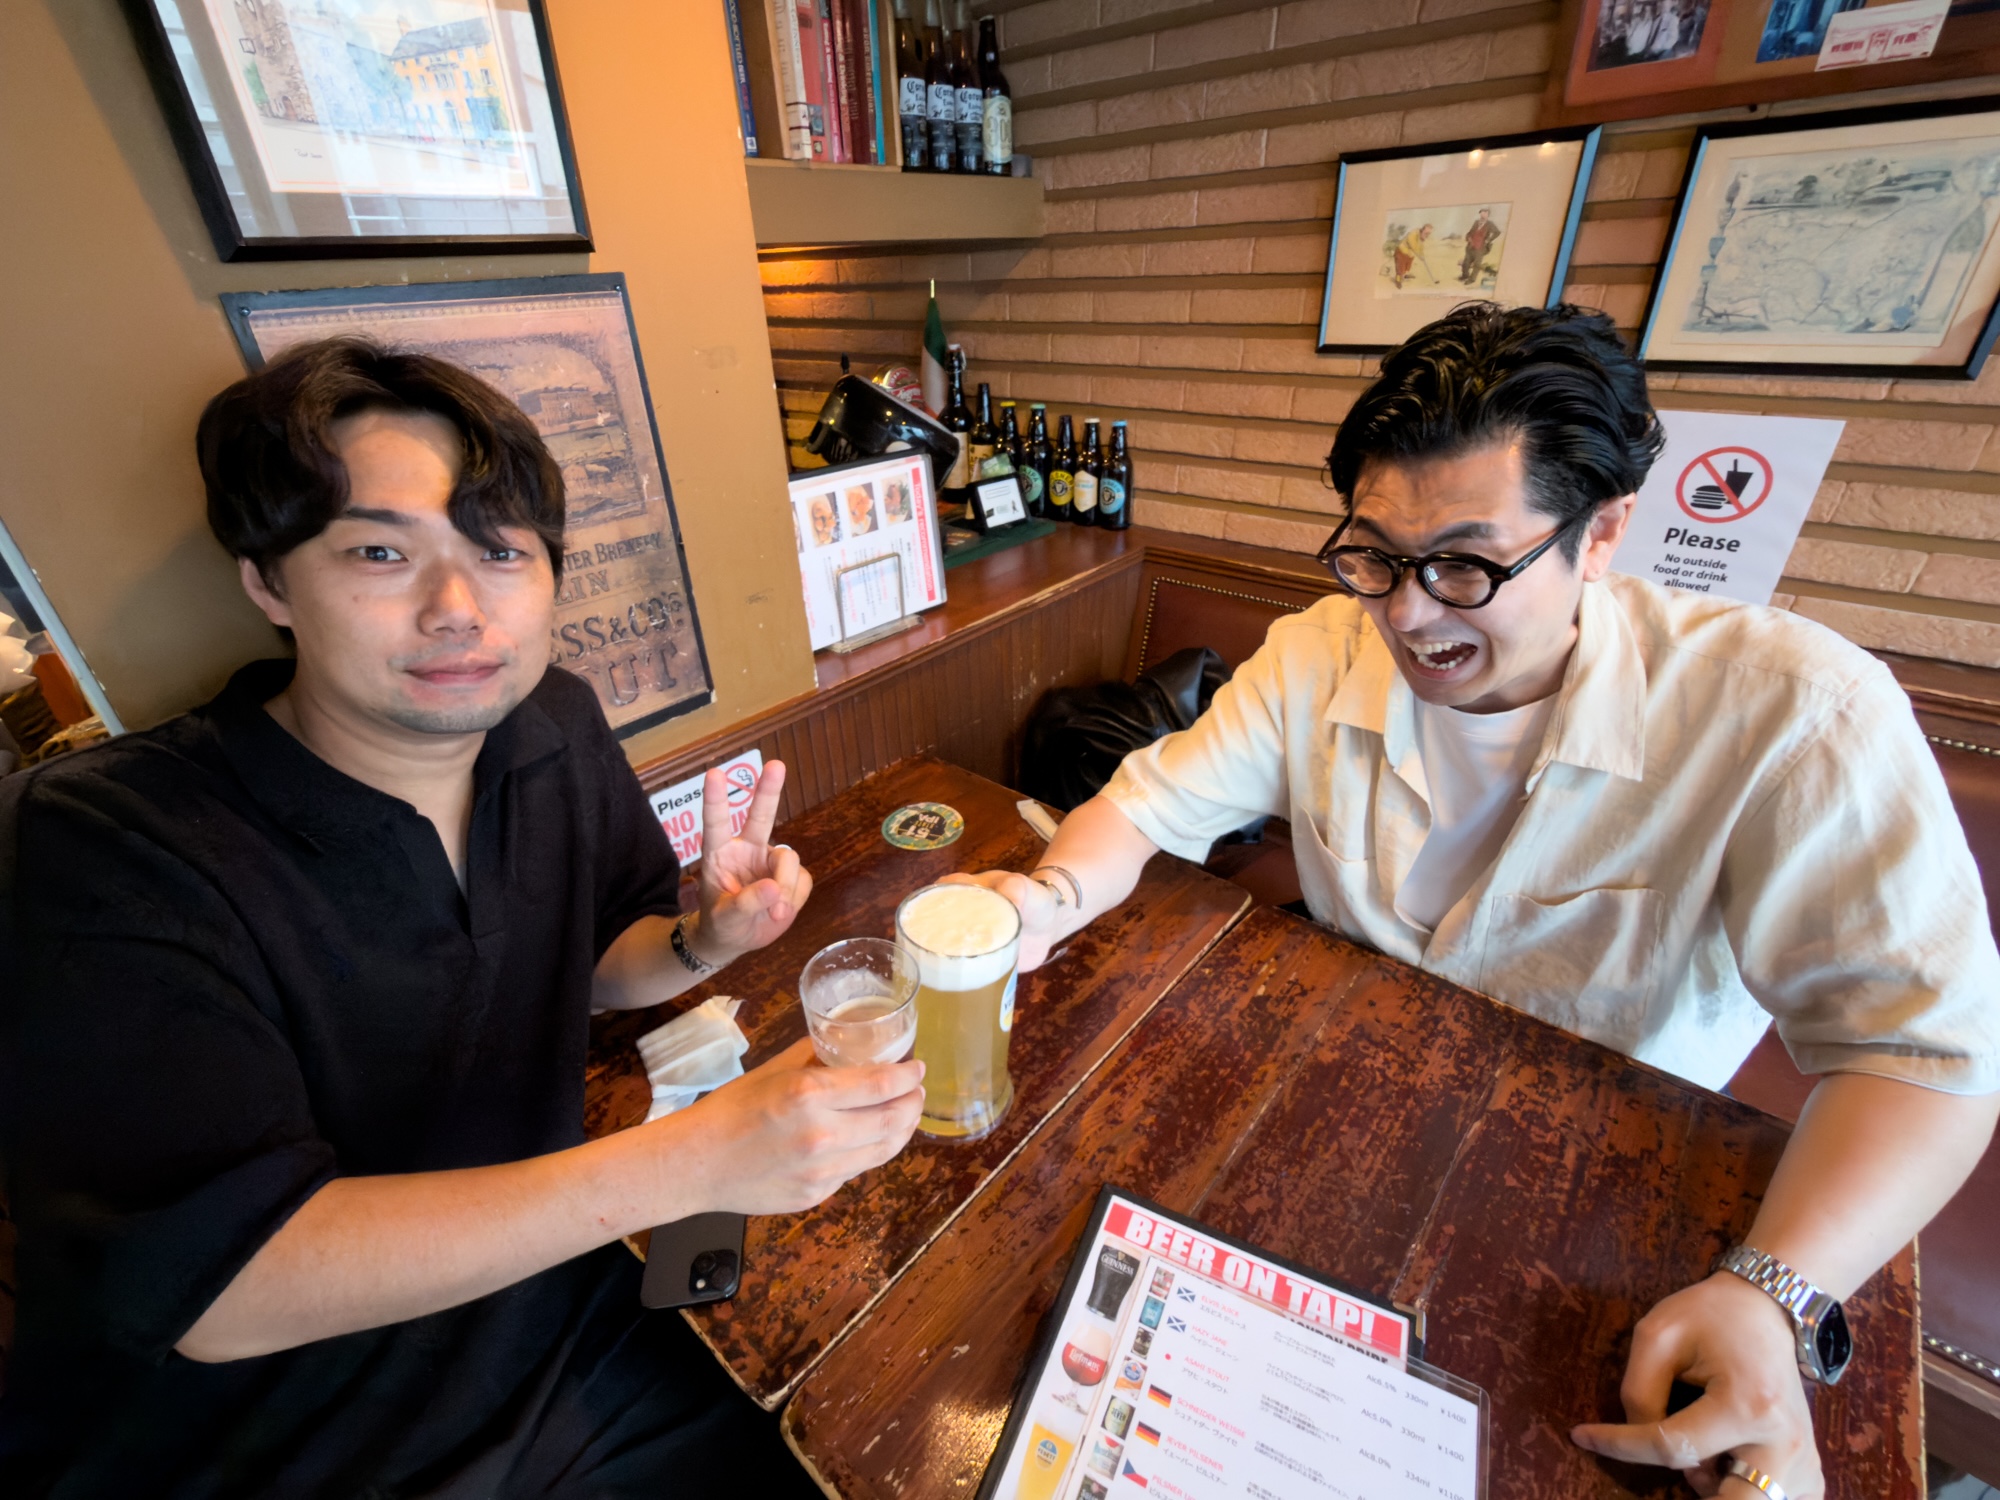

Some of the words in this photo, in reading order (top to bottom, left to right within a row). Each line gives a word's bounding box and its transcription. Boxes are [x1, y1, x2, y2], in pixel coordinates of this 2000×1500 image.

[738, 64, 746, 84] BEER
[840, 64, 848, 104] Drinking
[1663, 527, 1741, 552] Please
[562, 549, 593, 573] TER
[594, 532, 661, 564] BREWERY
[1664, 553, 1680, 564] No
[1682, 556, 1728, 570] outside
[1652, 564, 1681, 576] food
[1681, 568, 1694, 578] or
[1696, 569, 1728, 583] drink
[1664, 578, 1711, 592] allowed
[554, 569, 611, 606] LIN
[657, 786, 705, 816] Pleas
[661, 810, 695, 841] NO
[1100, 1254, 1134, 1276] GUINNESS
[1124, 1211, 1216, 1275] BEER
[1222, 1254, 1278, 1302] ON
[1286, 1276, 1375, 1344] TAP!
[1206, 1367, 1229, 1382] STOUT
[1175, 1397, 1217, 1422] SCHNEIDER
[1218, 1419, 1246, 1437] WEISSE
[1187, 1448, 1224, 1471] PILSENER
[1151, 1475, 1183, 1495] PILSNER
